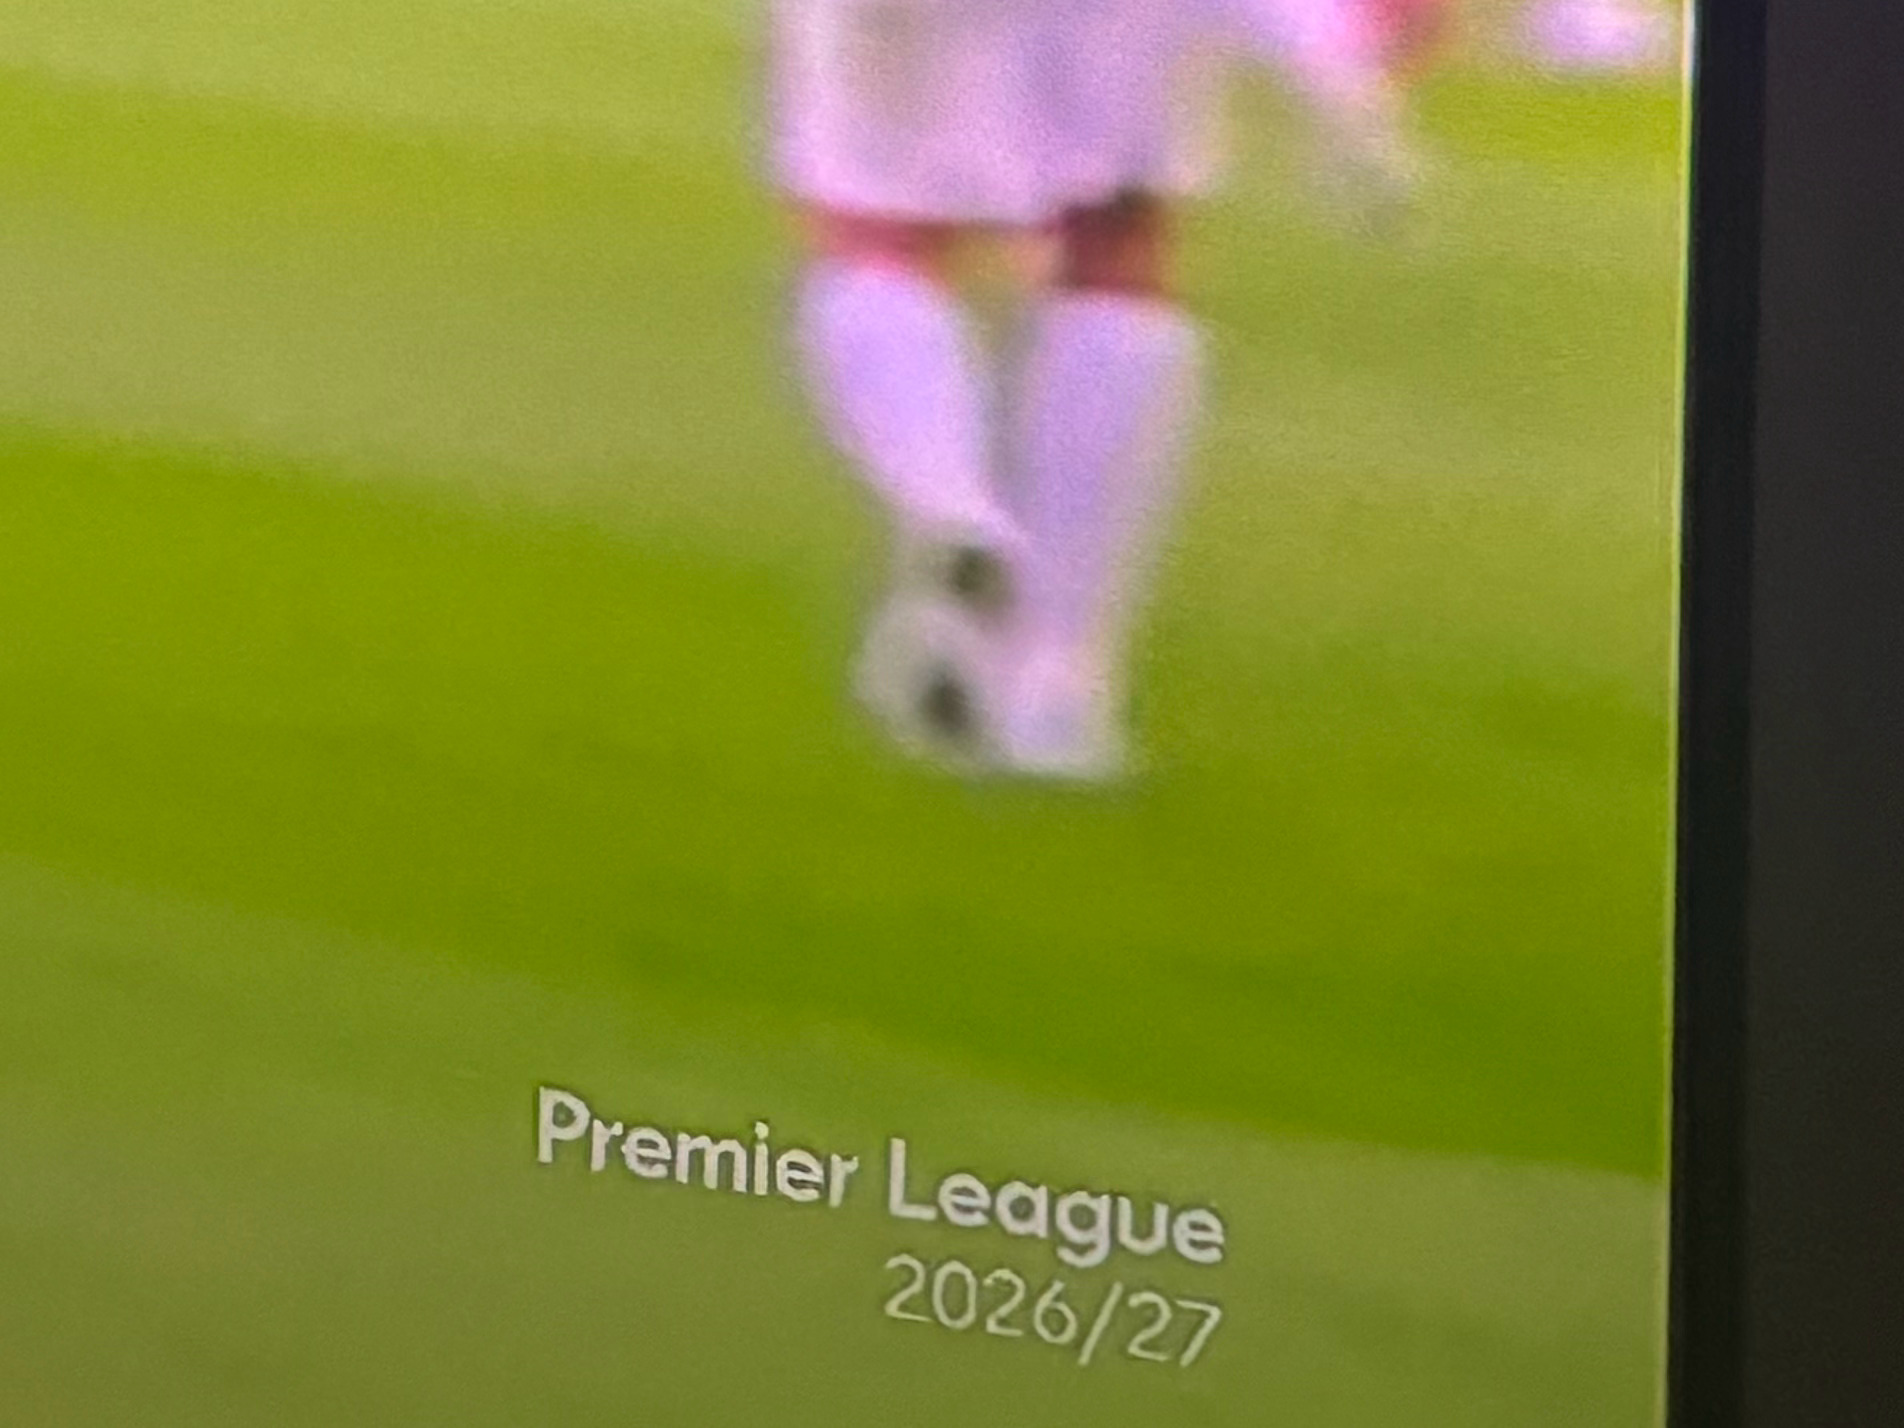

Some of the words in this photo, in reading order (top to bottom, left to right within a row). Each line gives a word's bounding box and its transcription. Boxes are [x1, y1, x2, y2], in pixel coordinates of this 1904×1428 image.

[536, 1085, 860, 1208] Premier
[888, 1137, 1226, 1270] League
[882, 1252, 1224, 1368] 2026/27
